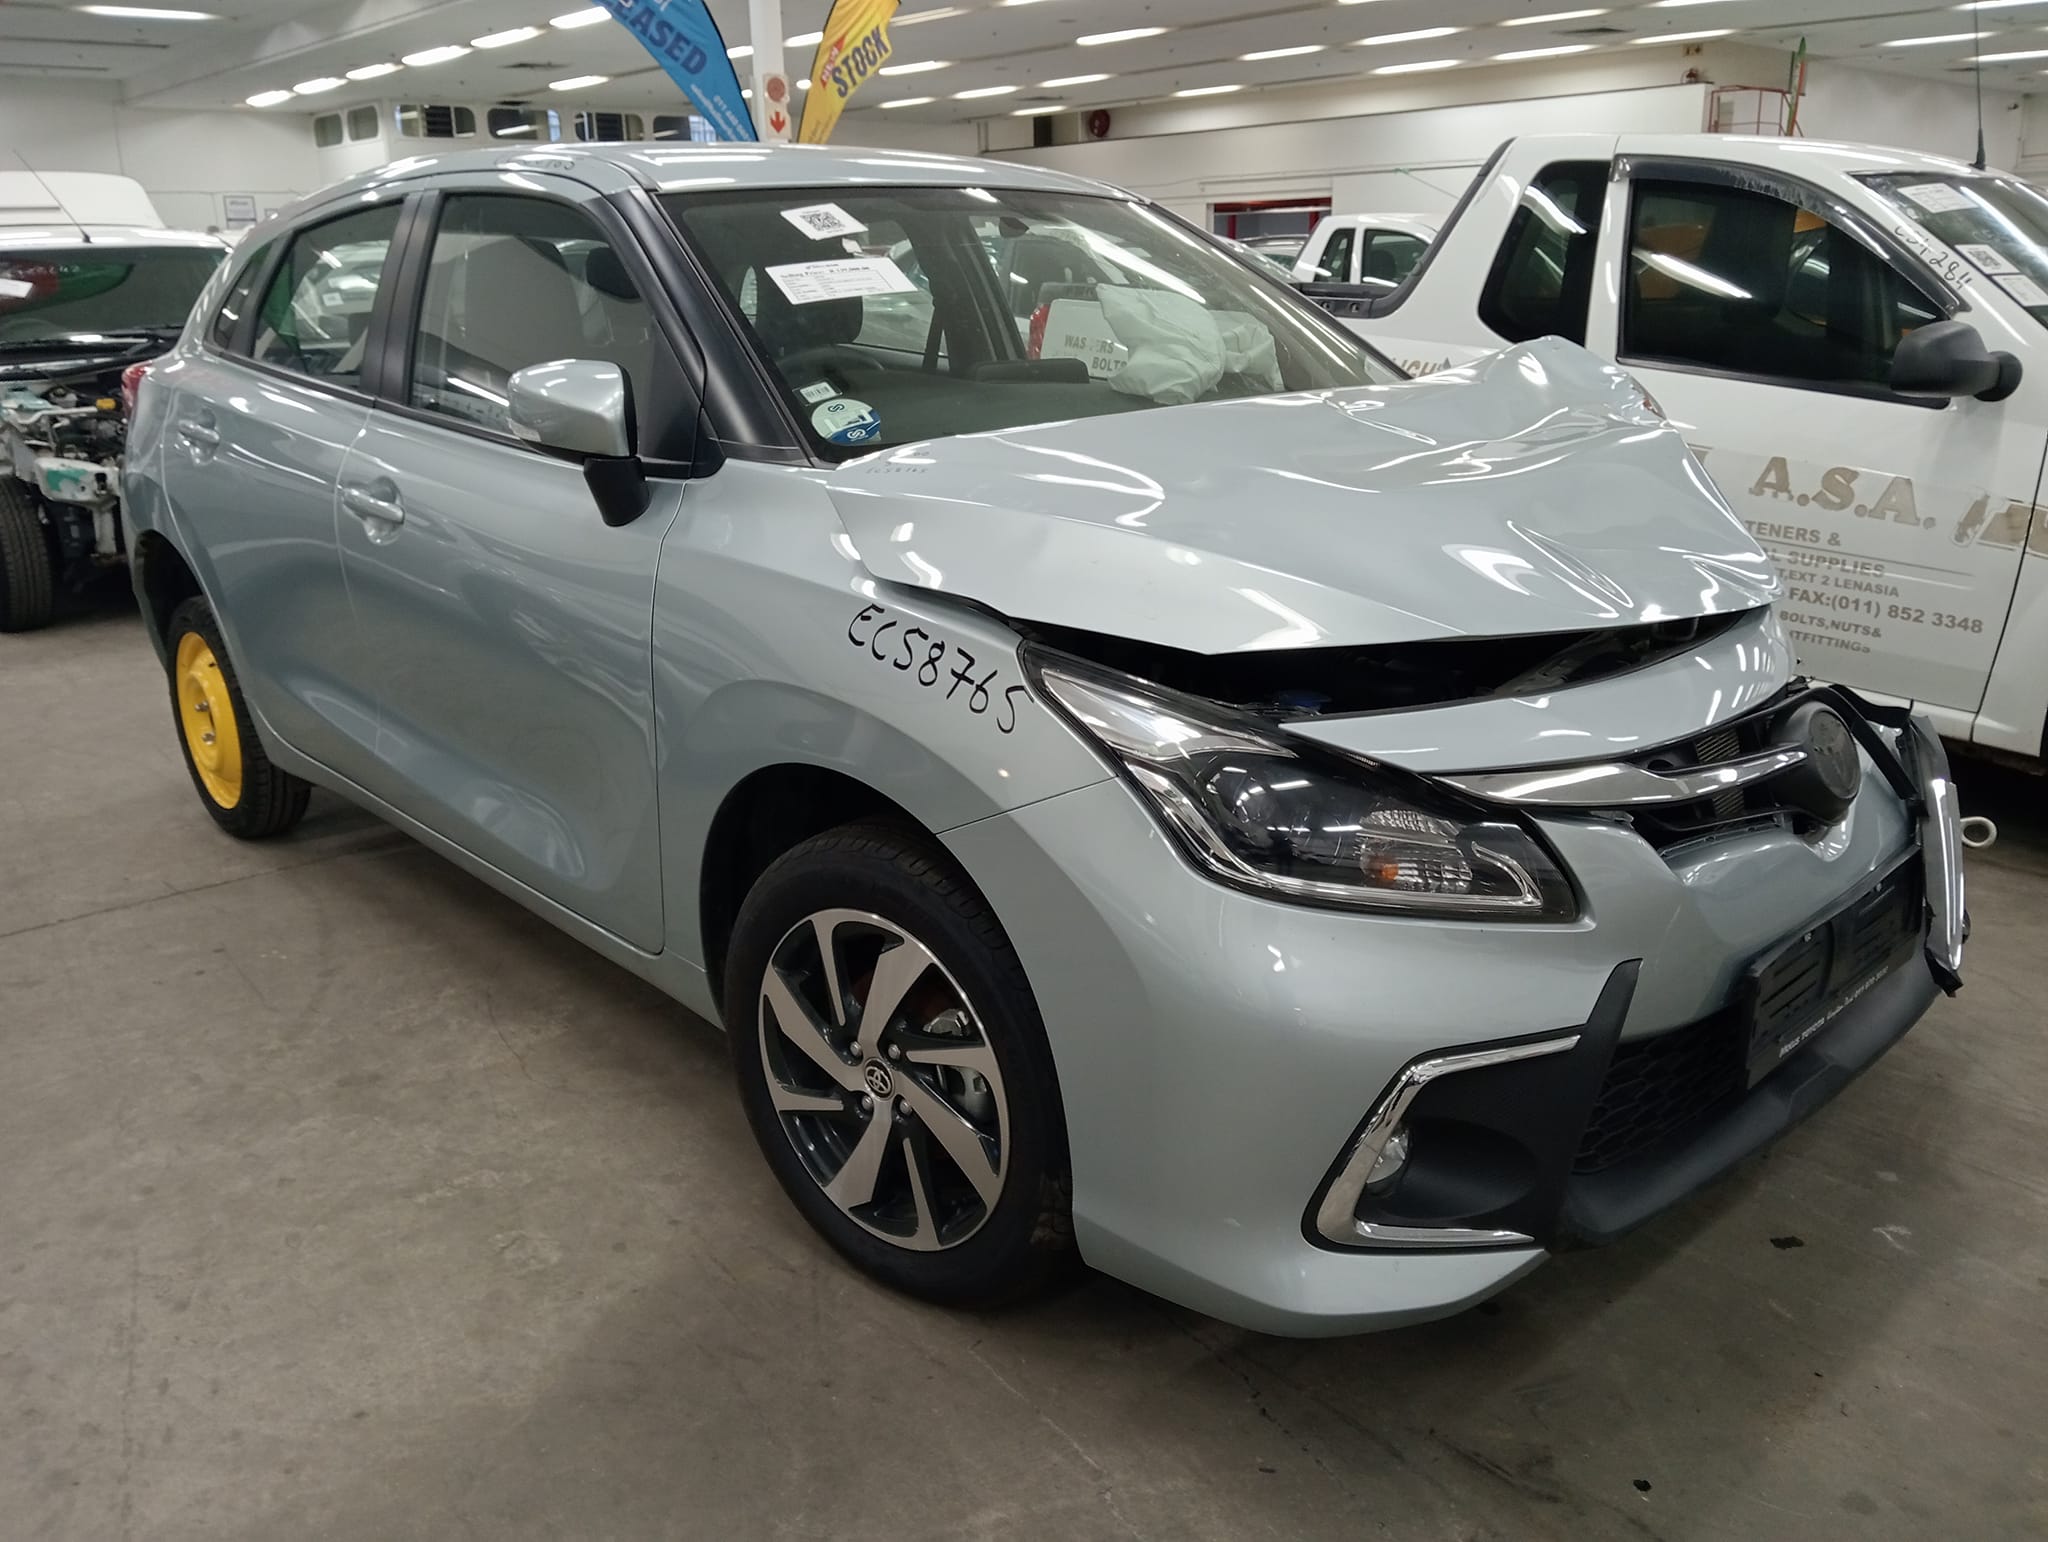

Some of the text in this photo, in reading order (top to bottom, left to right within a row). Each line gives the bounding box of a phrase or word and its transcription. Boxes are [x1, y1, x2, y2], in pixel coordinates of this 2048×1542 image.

[831, 24, 889, 98] STOCK
[1748, 455, 1937, 530] A.S.A.
[1827, 531, 1842, 546] &
[1787, 551, 1886, 579] SUPPLIES
[1820, 574, 1831, 587] 2
[1834, 577, 1900, 598] LENASIA
[1887, 603, 1926, 624] 852
[1931, 611, 1984, 634] 3348
